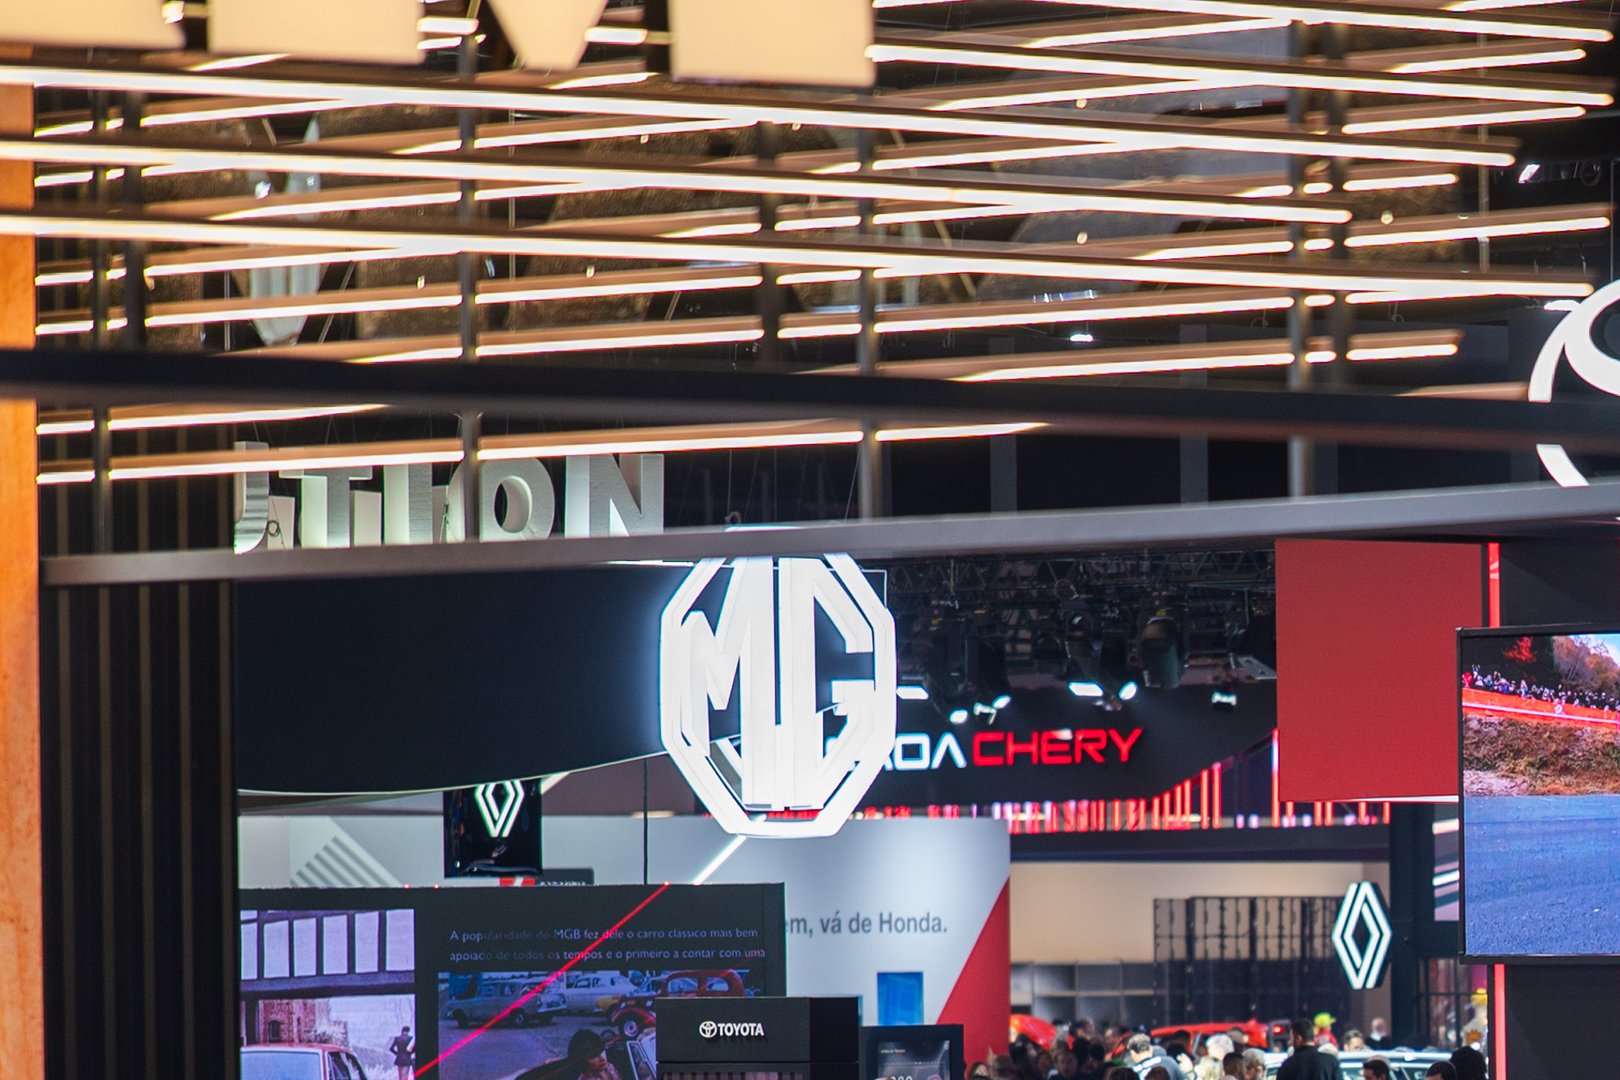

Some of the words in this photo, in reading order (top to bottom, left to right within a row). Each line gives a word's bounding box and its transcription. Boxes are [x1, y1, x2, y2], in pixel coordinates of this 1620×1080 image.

[680, 556, 876, 810] MG
[972, 728, 1143, 767] CHERY
[450, 930, 460, 940] A
[536, 929, 551, 940] do
[554, 928, 580, 940] MGB
[584, 928, 600, 940] fez
[603, 928, 625, 939] dele
[627, 930, 635, 939] o
[637, 929, 665, 939] carro
[710, 928, 733, 938] mais
[736, 927, 759, 938] bem
[785, 918, 814, 937] m,
[820, 910, 842, 933] vá
[848, 912, 872, 933] de
[879, 912, 948, 933] Honda.
[450, 951, 493, 964] apoiado
[496, 950, 510, 960] de
[513, 950, 544, 960] todos
[548, 951, 560, 960] os
[563, 950, 603, 963] tempos
[626, 949, 671, 962] primeiro
[682, 949, 716, 958] contar
[719, 949, 742, 958] com
[745, 948, 766, 958] uma
[718, 1023, 764, 1036] TOYOTA
